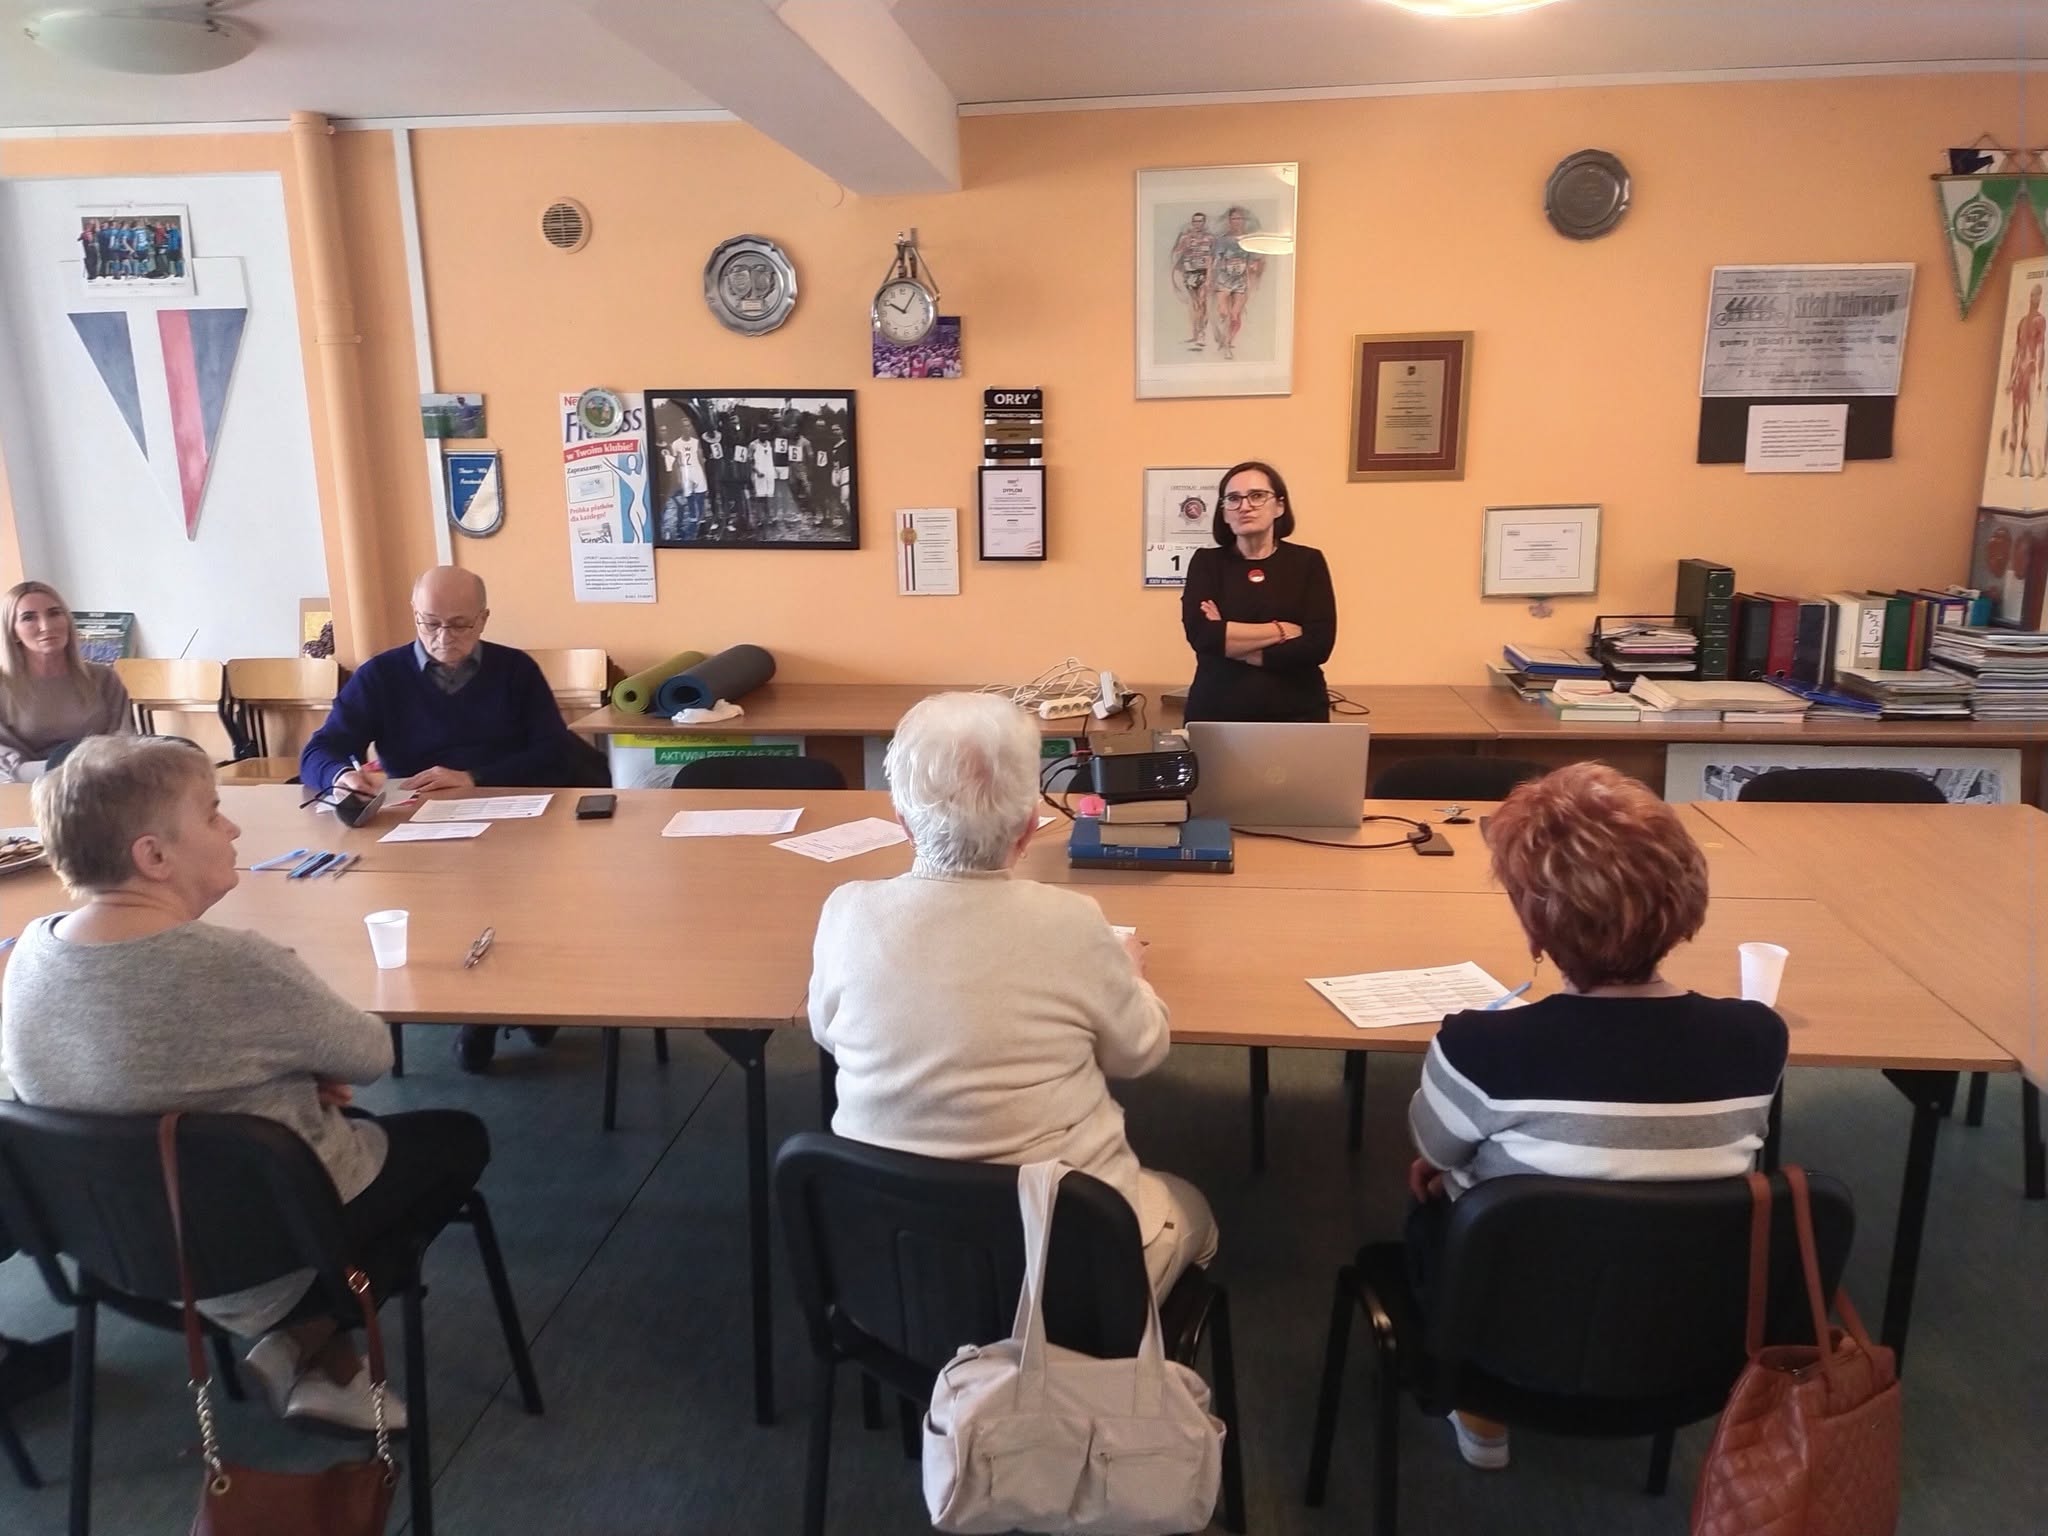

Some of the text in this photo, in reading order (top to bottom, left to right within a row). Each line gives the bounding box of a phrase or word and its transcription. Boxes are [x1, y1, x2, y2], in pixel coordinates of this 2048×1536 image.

[994, 393, 1031, 405] ORŁY
[565, 408, 642, 443] Fiss
[566, 442, 634, 461] w Twoim klubie!
[714, 444, 721, 457] 3
[780, 439, 786, 452] 5
[685, 452, 692, 466] 2
[739, 448, 745, 461] 4
[792, 447, 798, 460] 6
[819, 452, 825, 464] 7
[567, 464, 602, 474] Zapraszamy:
